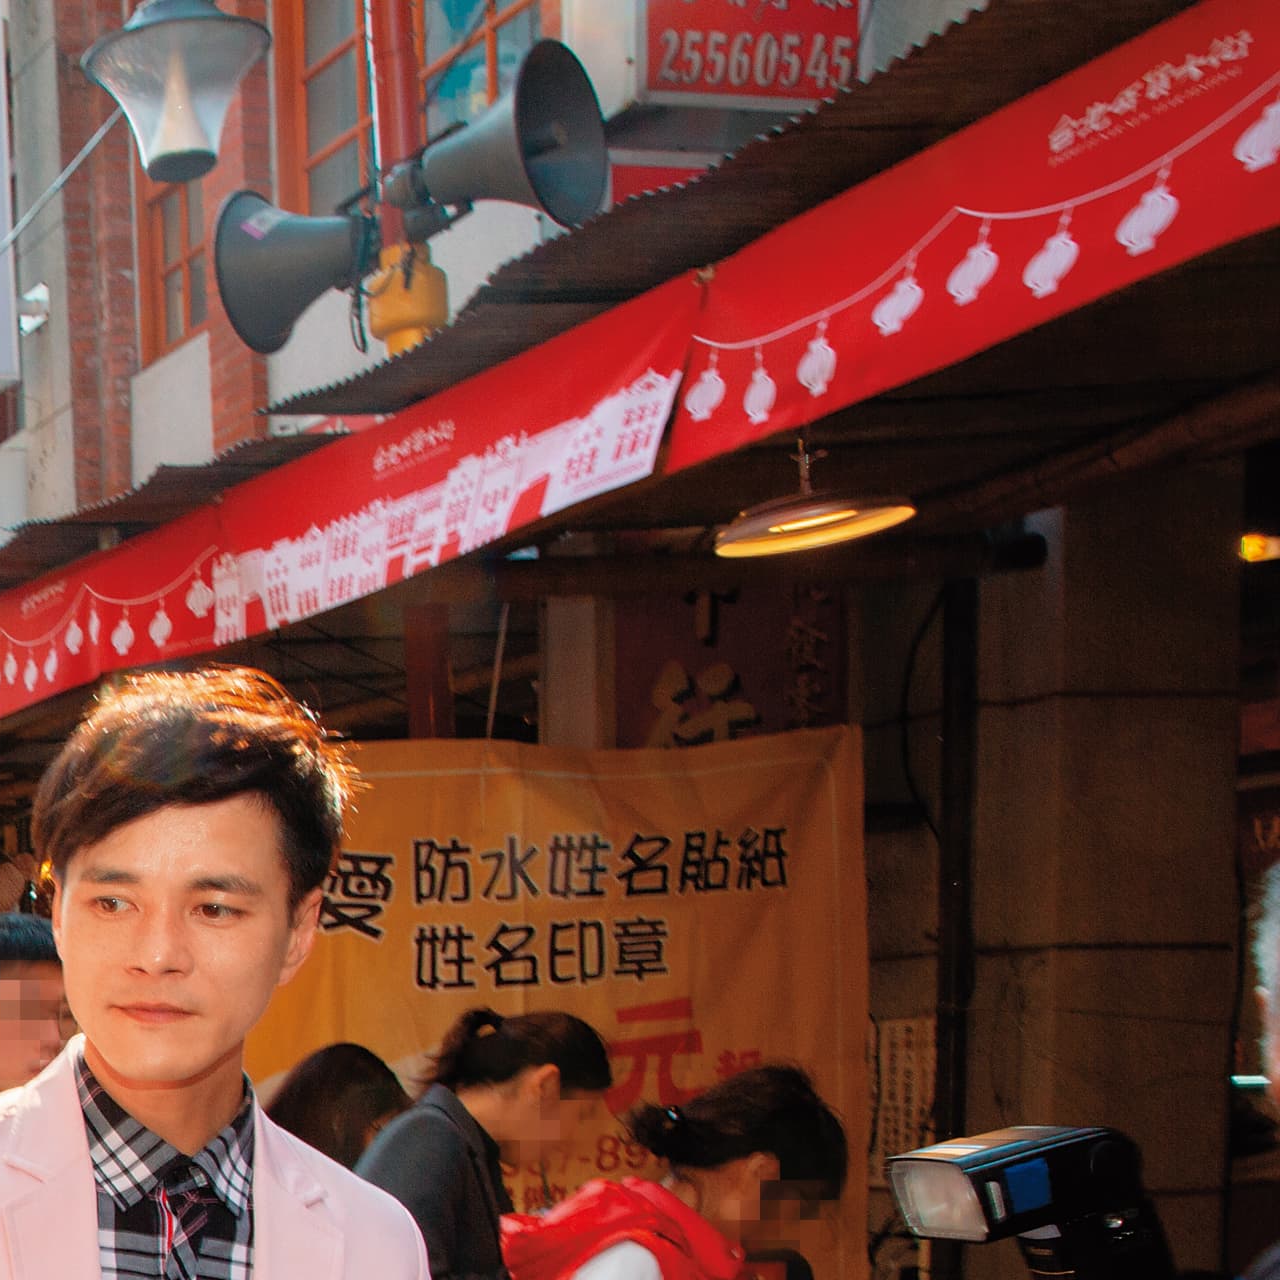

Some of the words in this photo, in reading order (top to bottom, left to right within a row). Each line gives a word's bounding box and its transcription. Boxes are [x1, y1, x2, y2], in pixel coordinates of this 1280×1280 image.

[659, 28, 853, 88] 25560545
[412, 826, 788, 904] 防水姓名貼紙
[414, 916, 669, 992] 姓名印章
